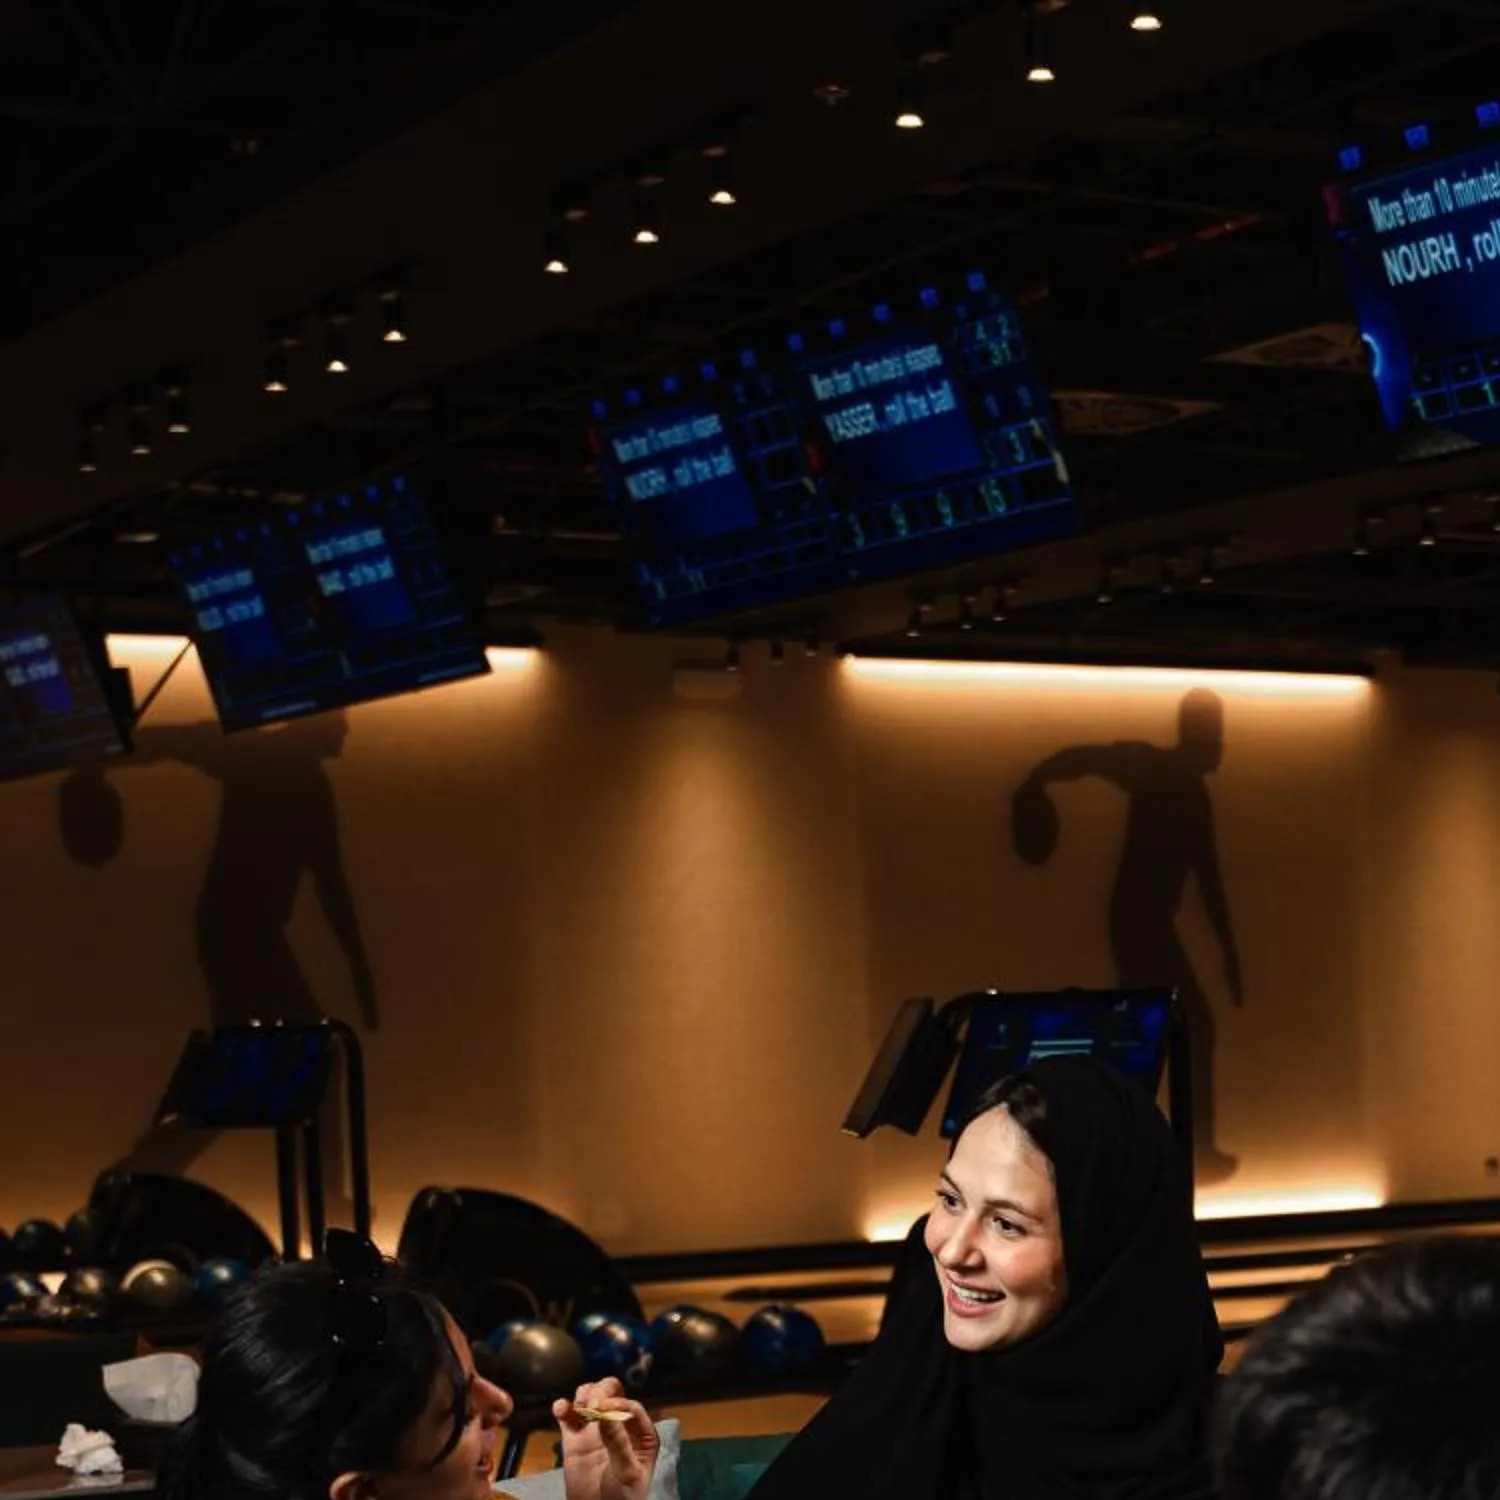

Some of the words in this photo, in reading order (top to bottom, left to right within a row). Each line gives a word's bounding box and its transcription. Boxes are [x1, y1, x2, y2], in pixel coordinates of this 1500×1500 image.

[1366, 196, 1407, 234] More
[1402, 186, 1436, 225] than
[1432, 175, 1454, 214] 10
[1382, 232, 1461, 288] NOURH
